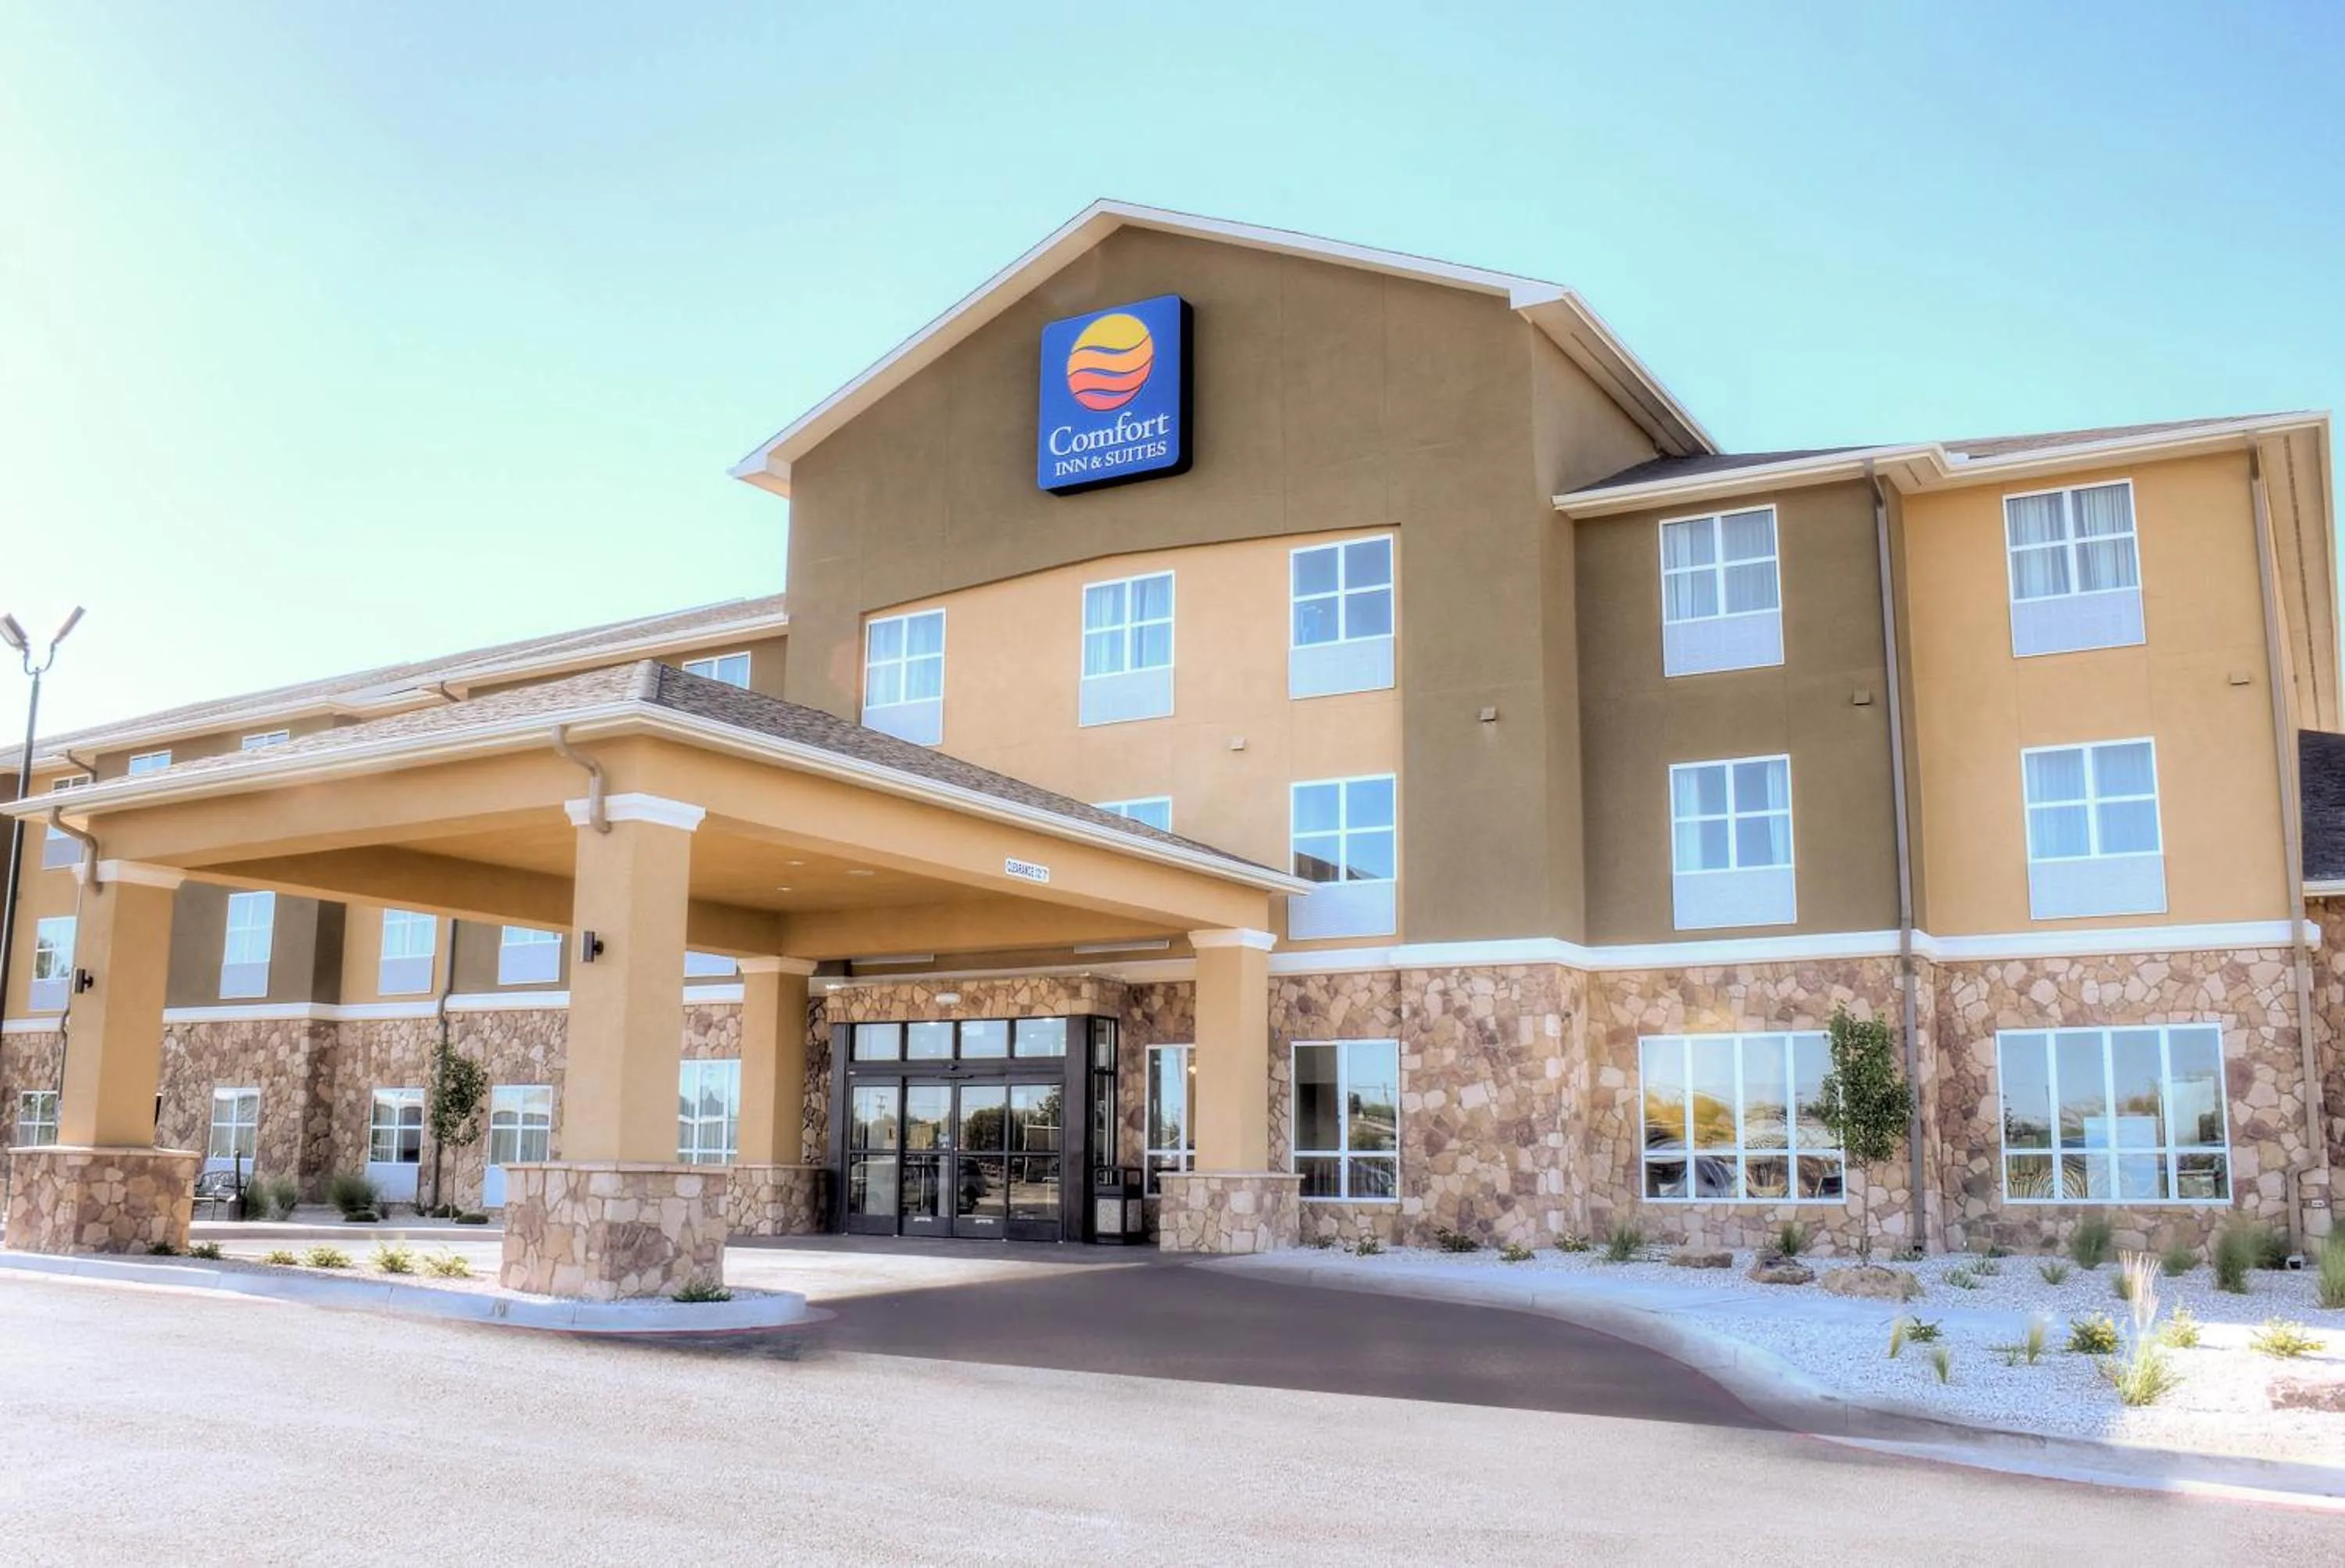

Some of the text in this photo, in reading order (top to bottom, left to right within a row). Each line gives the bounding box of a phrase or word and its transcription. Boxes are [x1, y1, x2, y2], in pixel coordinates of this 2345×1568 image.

[1049, 411, 1170, 456] Comfort
[1055, 440, 1167, 476] INN & SUITES
